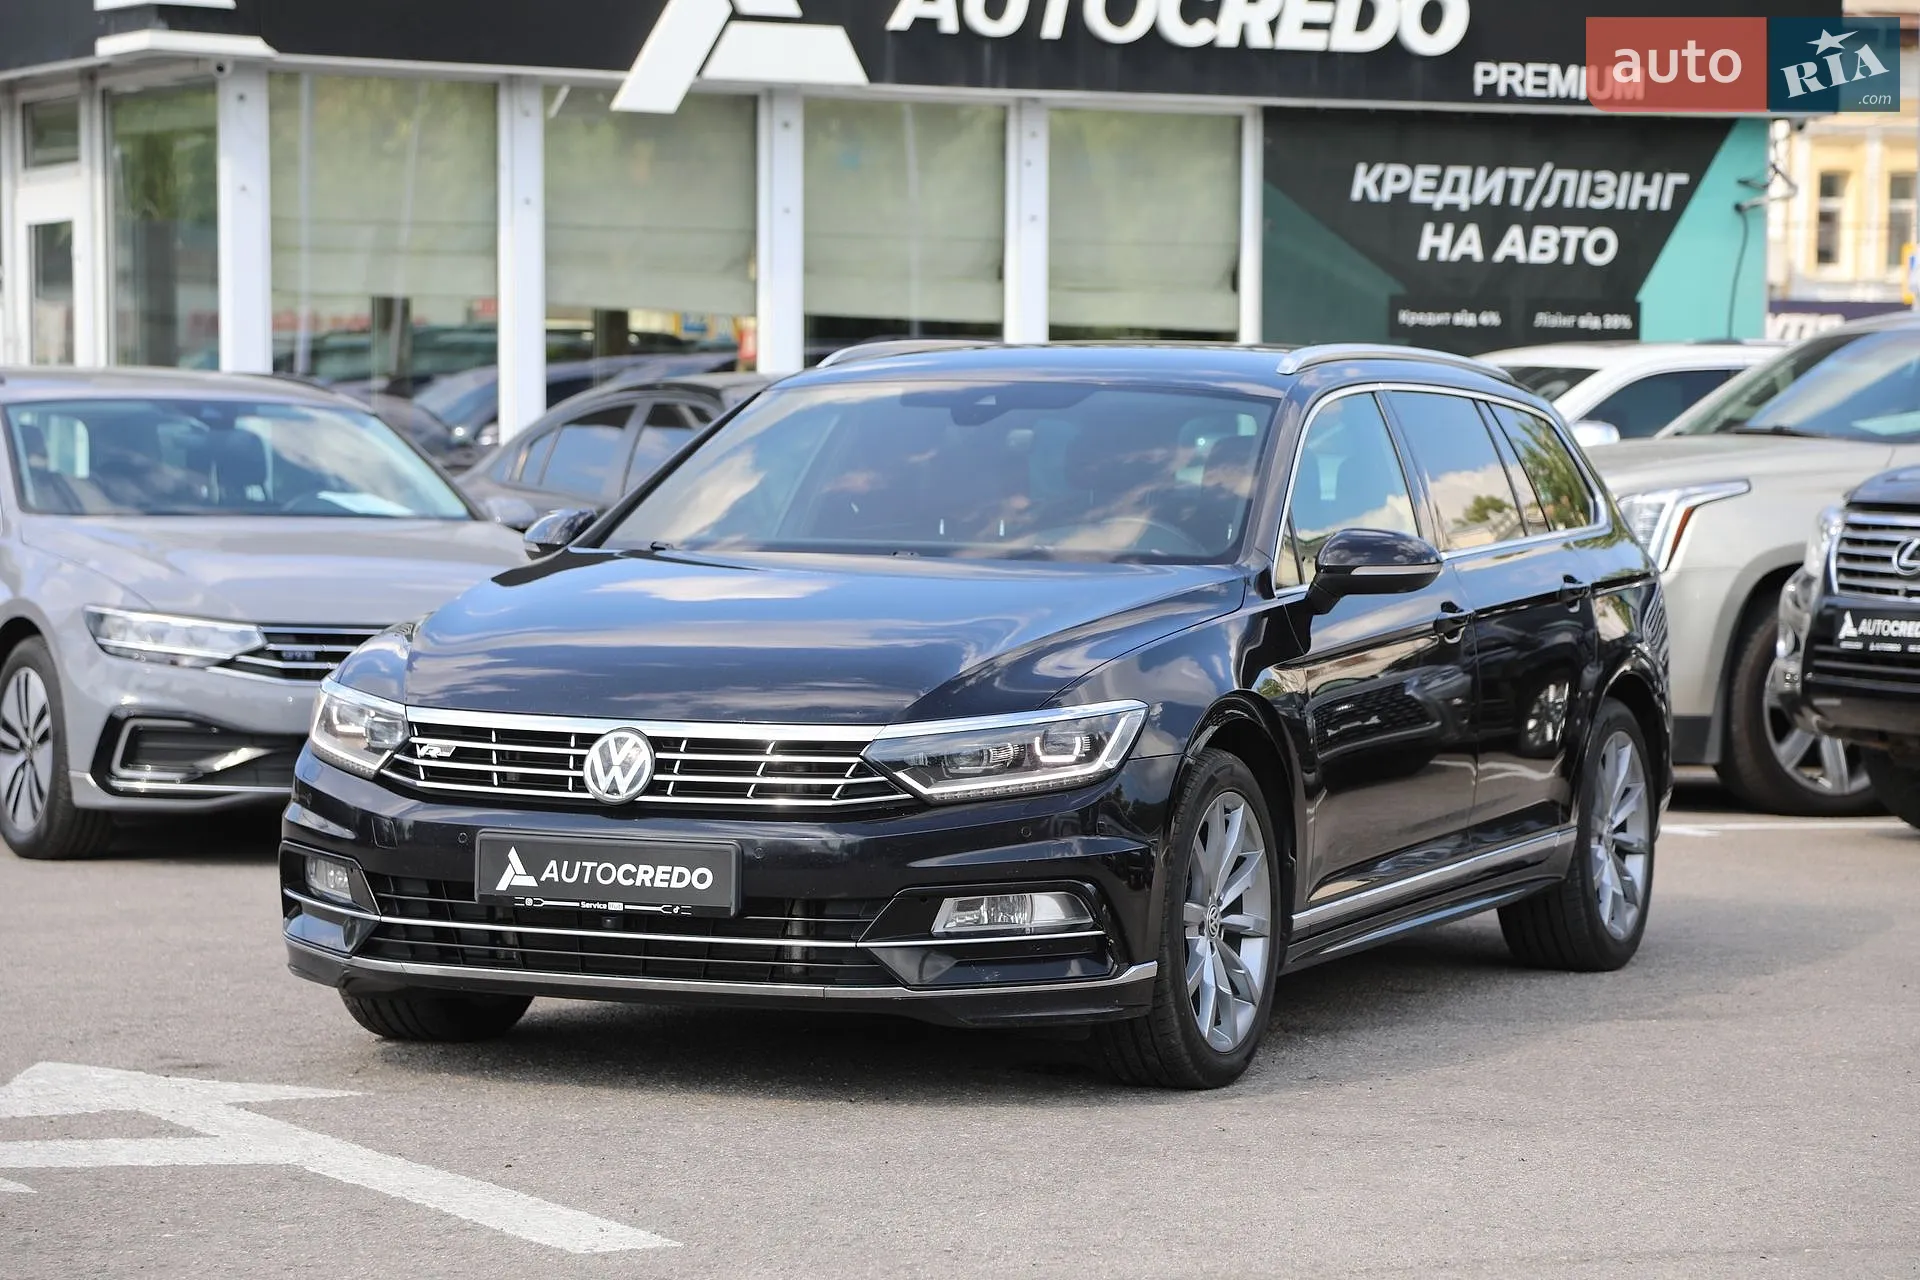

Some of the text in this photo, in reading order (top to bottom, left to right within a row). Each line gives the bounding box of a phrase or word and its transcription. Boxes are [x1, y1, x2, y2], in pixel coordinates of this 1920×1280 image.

[1350, 162, 1689, 211] КРЕДИТ/ЛІЗІНГ
[1417, 222, 1619, 266] НА АВТО
[540, 860, 714, 890] AUTOCREDO
[580, 901, 607, 909] Service
